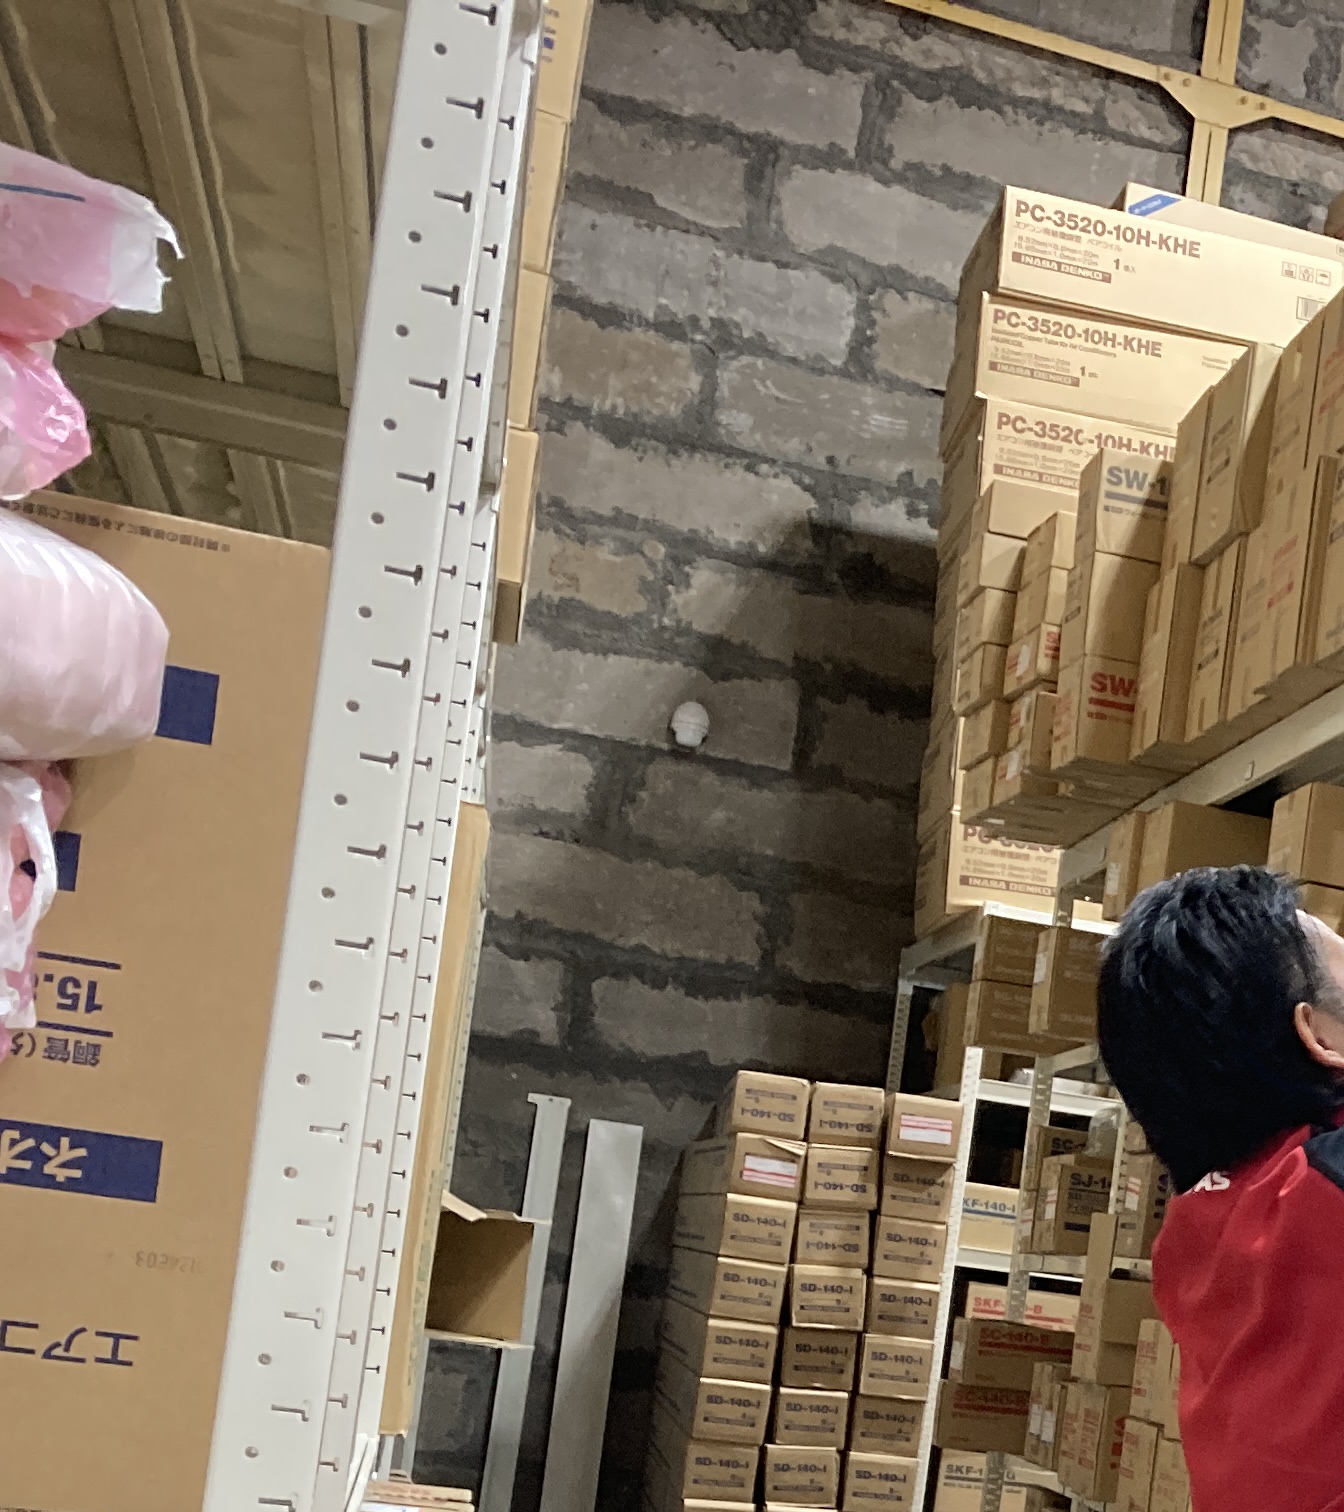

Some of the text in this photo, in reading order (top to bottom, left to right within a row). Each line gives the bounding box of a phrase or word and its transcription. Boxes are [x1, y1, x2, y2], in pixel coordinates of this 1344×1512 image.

[1015, 199, 1200, 259] PC-3520-10H-KHE
[993, 308, 1162, 358] PC-3520-10H-KHE
[33, 973, 103, 1014] 15.
